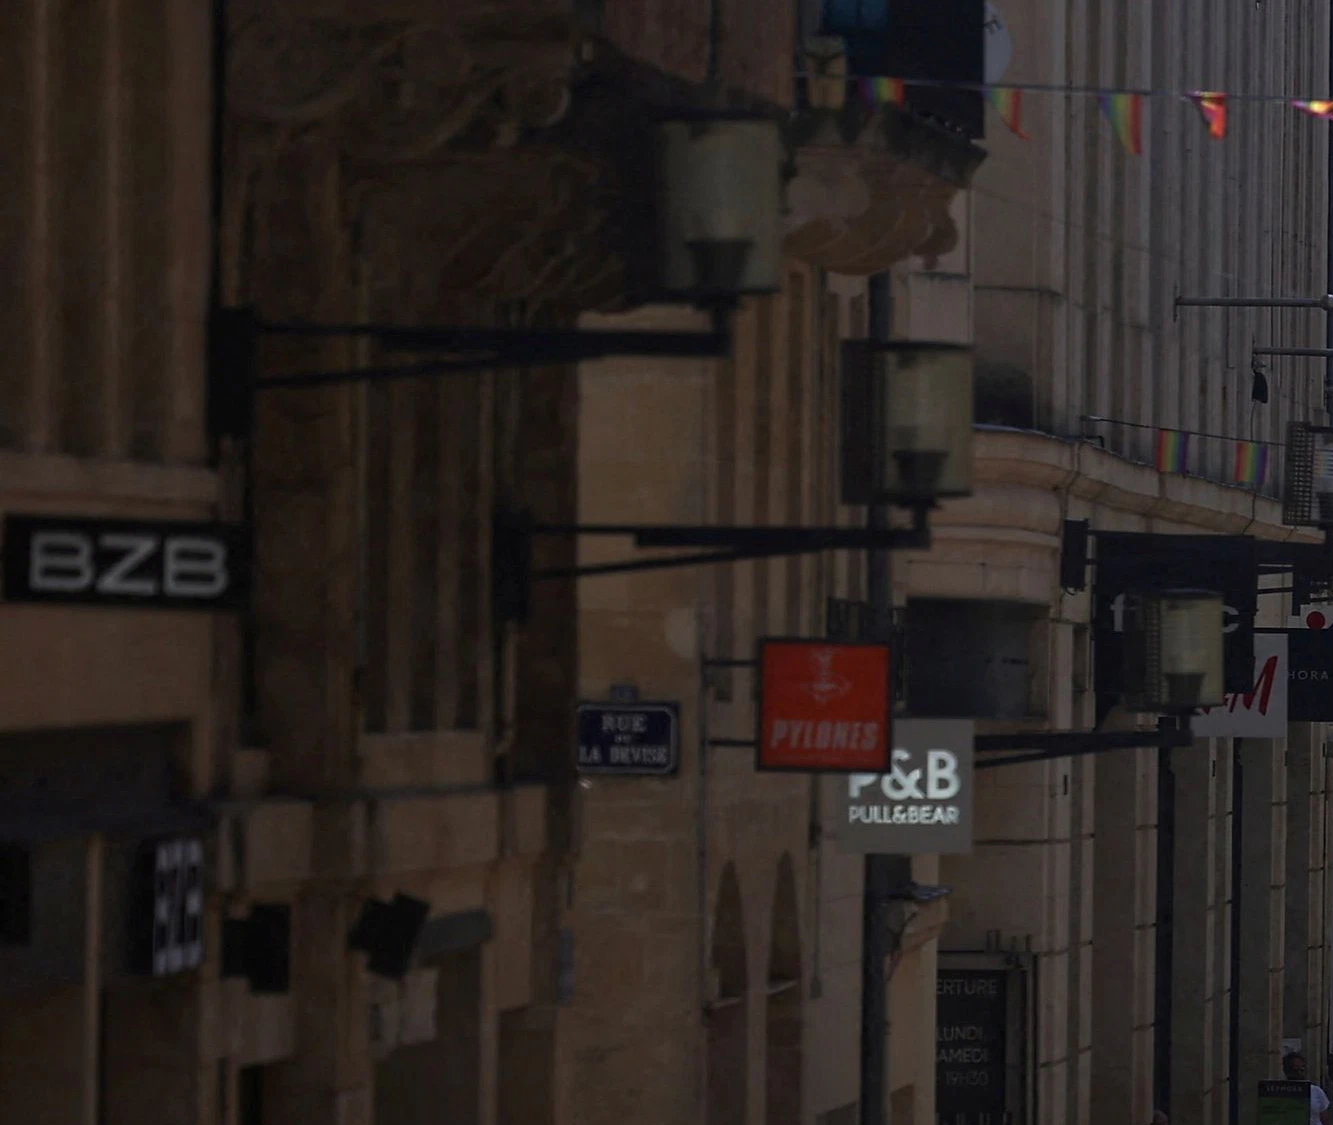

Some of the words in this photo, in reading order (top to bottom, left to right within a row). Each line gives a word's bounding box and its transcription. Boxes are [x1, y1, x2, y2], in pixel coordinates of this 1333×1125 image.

[28, 530, 229, 598] BZB
[1288, 670, 1328, 680] HORA
[601, 712, 648, 734] RUE
[769, 716, 880, 751] PYLONES
[579, 744, 602, 764] LA
[848, 805, 961, 825] PULL&BEAR
[937, 979, 998, 995] ERTURE
[938, 1048, 988, 1063] AMEDI
